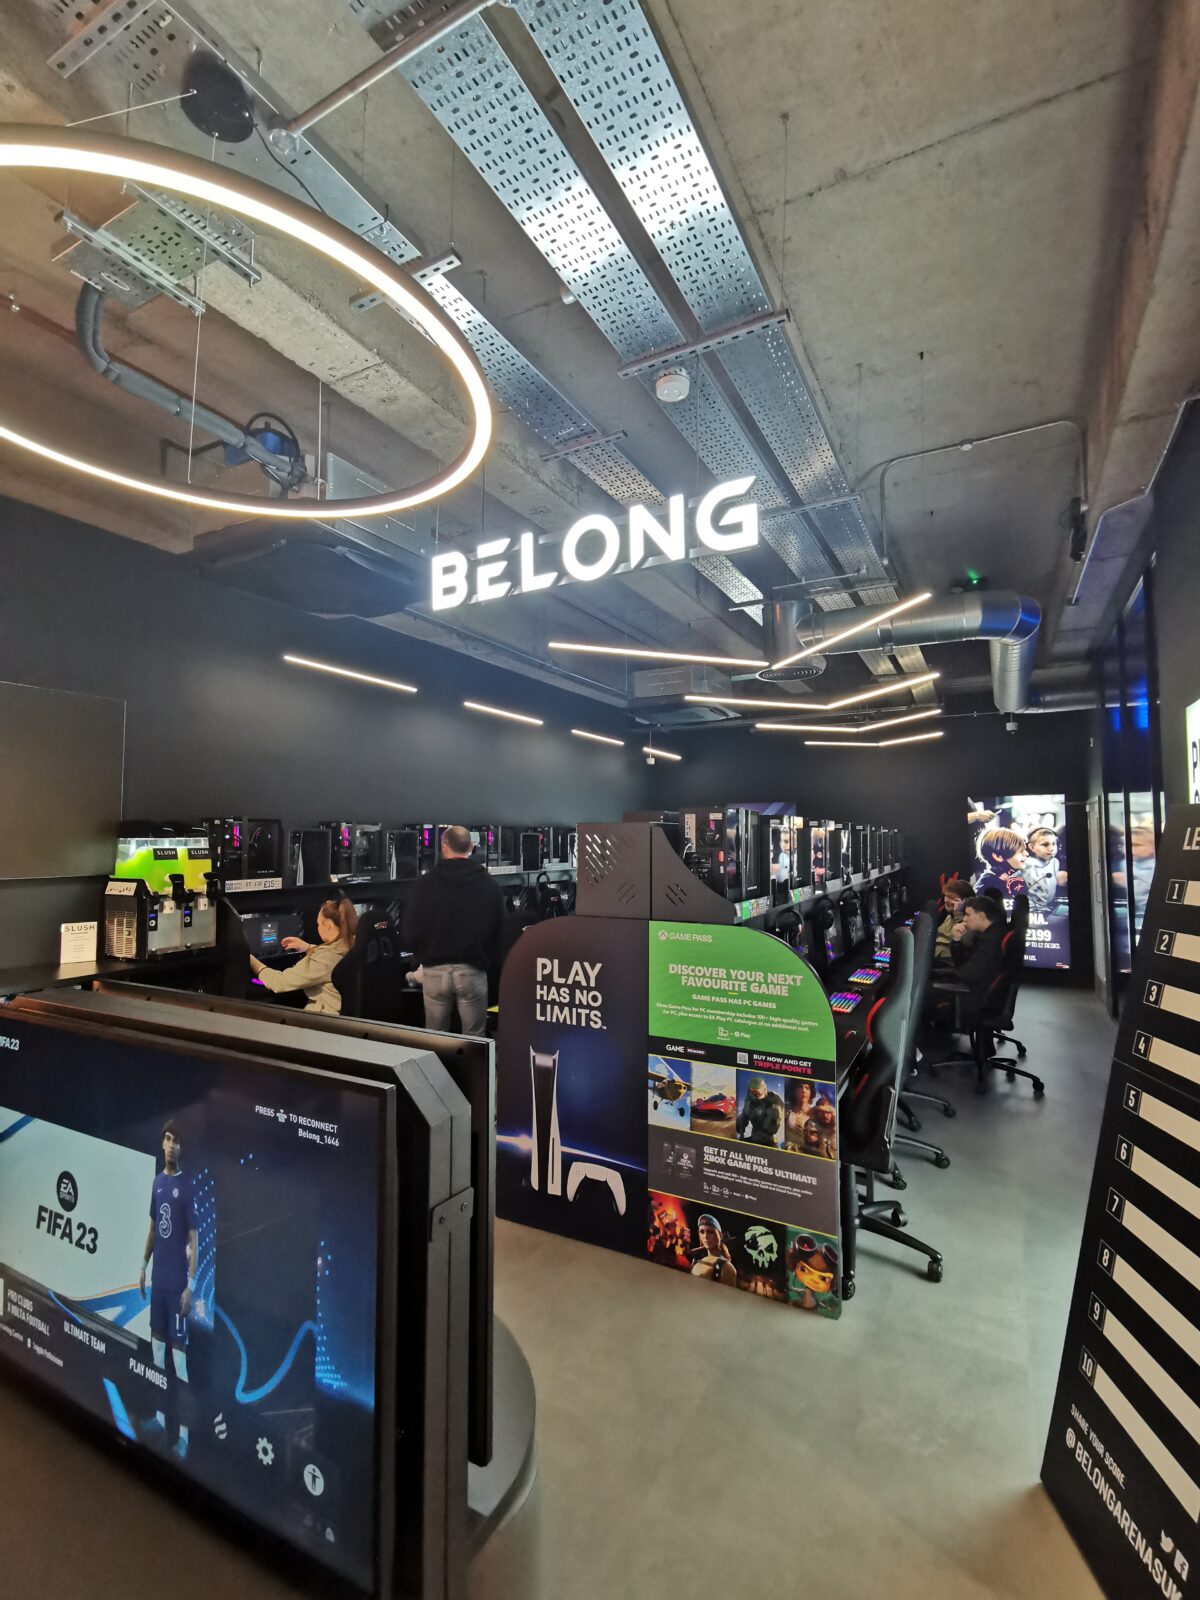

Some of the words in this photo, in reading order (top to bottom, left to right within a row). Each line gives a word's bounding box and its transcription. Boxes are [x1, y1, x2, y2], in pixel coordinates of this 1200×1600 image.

[431, 475, 759, 611] BELONG
[1172, 884, 1179, 899] 1
[65, 924, 95, 932] SLUSH
[670, 932, 692, 941] GAME
[692, 934, 712, 942] PASS
[1160, 934, 1169, 951] 2
[536, 957, 602, 987] PLAY
[668, 964, 727, 979] DISCOVER
[729, 969, 764, 982] YOUR
[768, 972, 803, 986] NEXT
[681, 976, 747, 992] FAVOURITE
[750, 983, 789, 996] GAME
[1149, 985, 1158, 1002] 3
[536, 984, 570, 1004] HAS
[575, 988, 602, 1007] NO
[692, 994, 711, 1002] GAME
[753, 1000, 776, 1009] GAMES
[666, 1044, 684, 1053] GAME
[1138, 1036, 1145, 1054] 4
[753, 1060, 781, 1070] TRIPLE
[781, 1065, 812, 1075] POINTS
[799, 1060, 812, 1068] GET
[1128, 1090, 1136, 1107] 5
[255, 1105, 275, 1117] PRESS
[289, 1113, 298, 1123] TO
[298, 1116, 338, 1133] RECONNECT
[298, 1128, 340, 1146] Belong_1646
[704, 1146, 718, 1155] GET
[720, 1149, 727, 1157] IT
[728, 1151, 744, 1160] ALL
[745, 1154, 768, 1166] WITH
[1120, 1142, 1128, 1160] 6
[704, 1154, 726, 1165] XBOX
[726, 1158, 752, 1171] GAME
[752, 1164, 774, 1175] PASS
[774, 1169, 818, 1186] ULTIMATE
[60, 1179, 74, 1196] EA
[1112, 1195, 1119, 1212] 7
[36, 1204, 73, 1244] FIFA
[75, 1222, 98, 1254] 23
[159, 1202, 172, 1238] 3
[1102, 1248, 1110, 1267] 8
[1093, 1302, 1101, 1320] 9
[26, 1312, 50, 1336] FOOTBALL
[64, 1320, 90, 1346] ULTIMATE
[90, 1334, 106, 1355] TEAM
[129, 1357, 145, 1377] PLAY
[146, 1366, 168, 1390] MODES
[1082, 1352, 1093, 1377] 10
[1070, 1403, 1089, 1436] SHARE
[1089, 1429, 1105, 1458] YOUR
